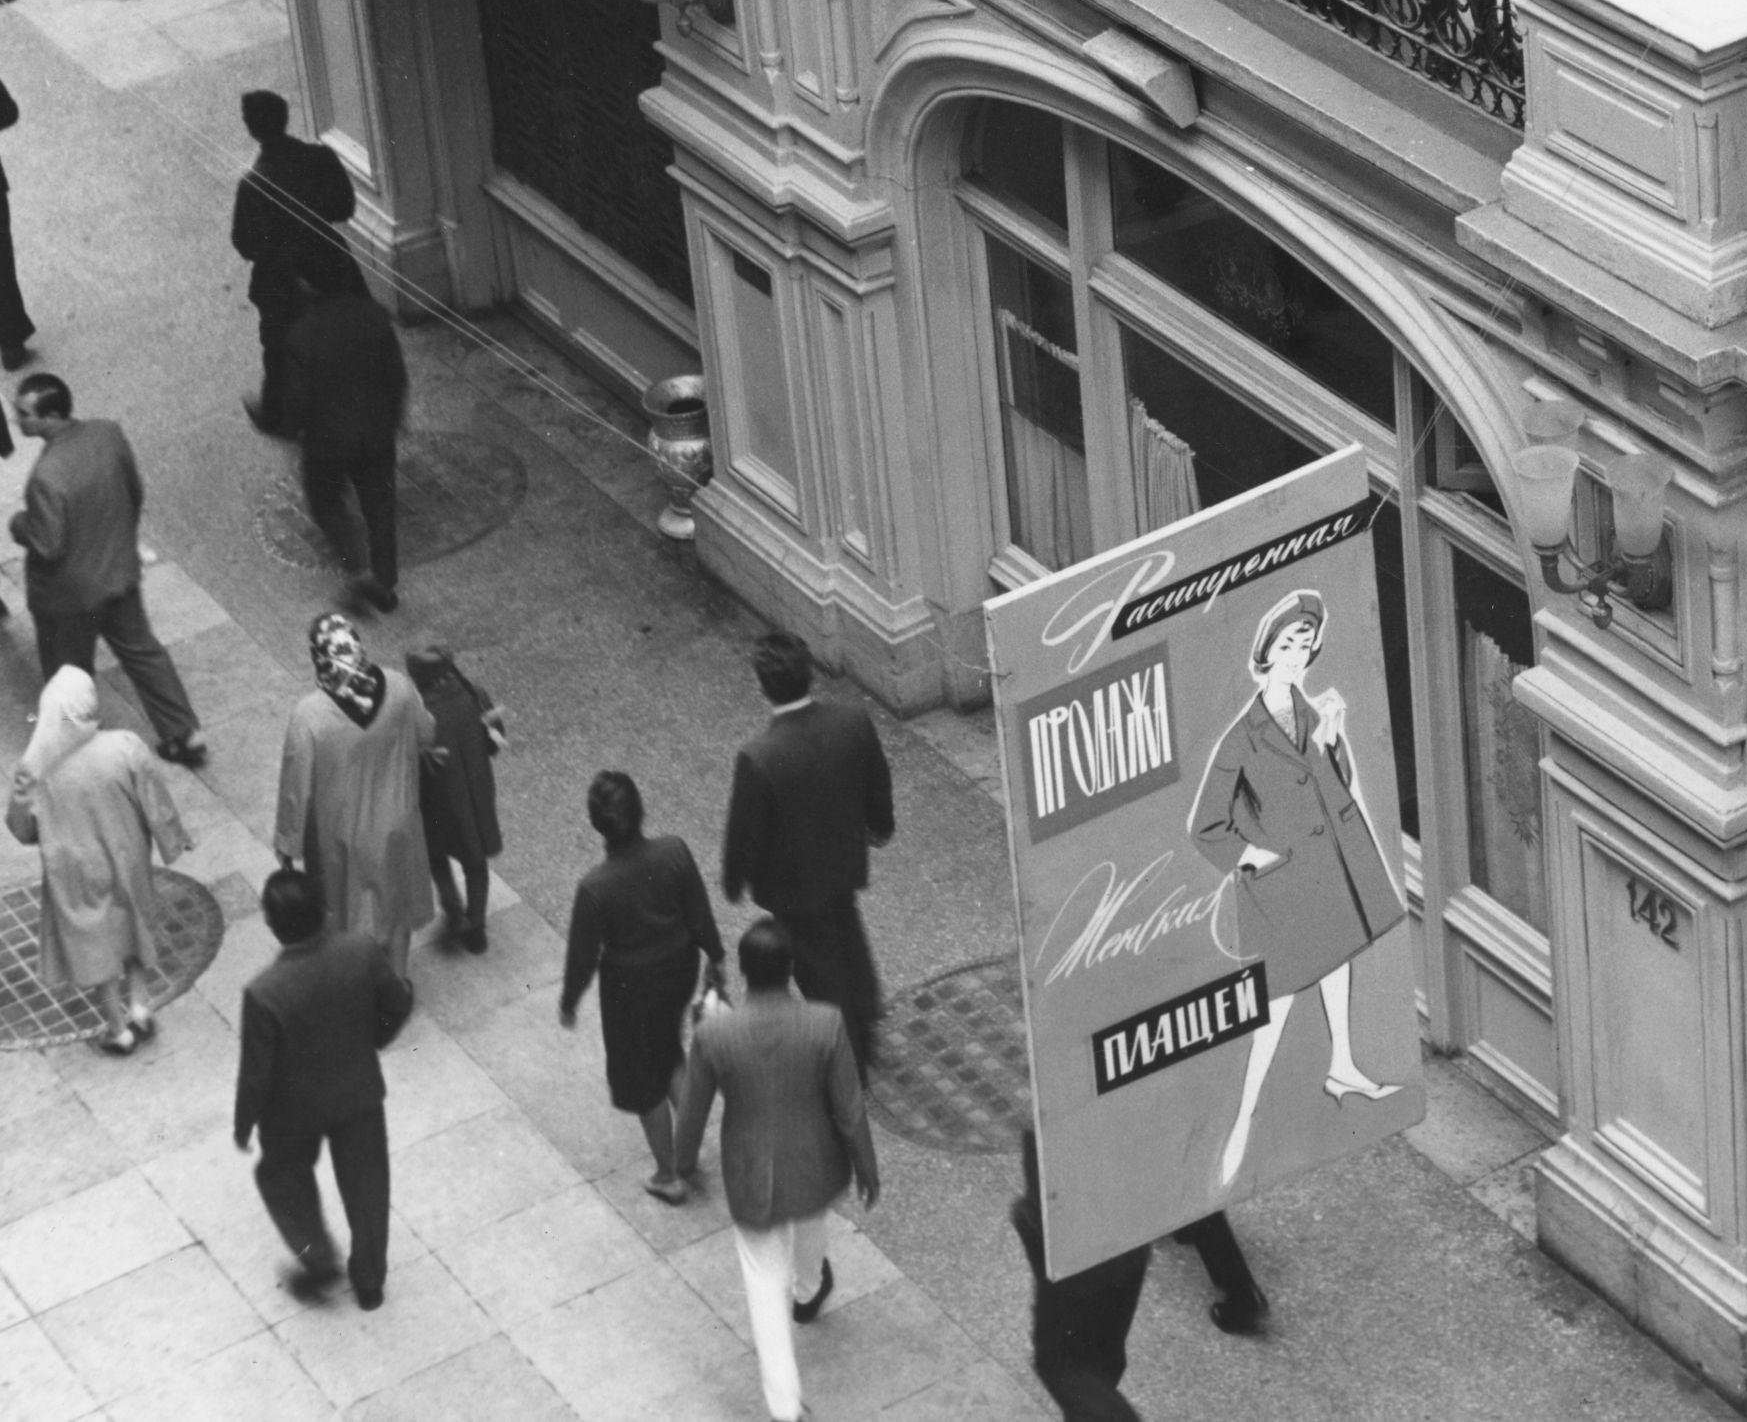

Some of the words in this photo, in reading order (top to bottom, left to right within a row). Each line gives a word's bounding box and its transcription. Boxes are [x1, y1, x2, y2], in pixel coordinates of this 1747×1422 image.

[1041, 508, 1361, 674] Расширенная
[1029, 662, 1173, 819] ПРОДАЖА
[1034, 849, 1260, 987] Женских
[1626, 877, 1681, 953] 142
[1102, 970, 1259, 1082] ПЛАЩЕЙ
